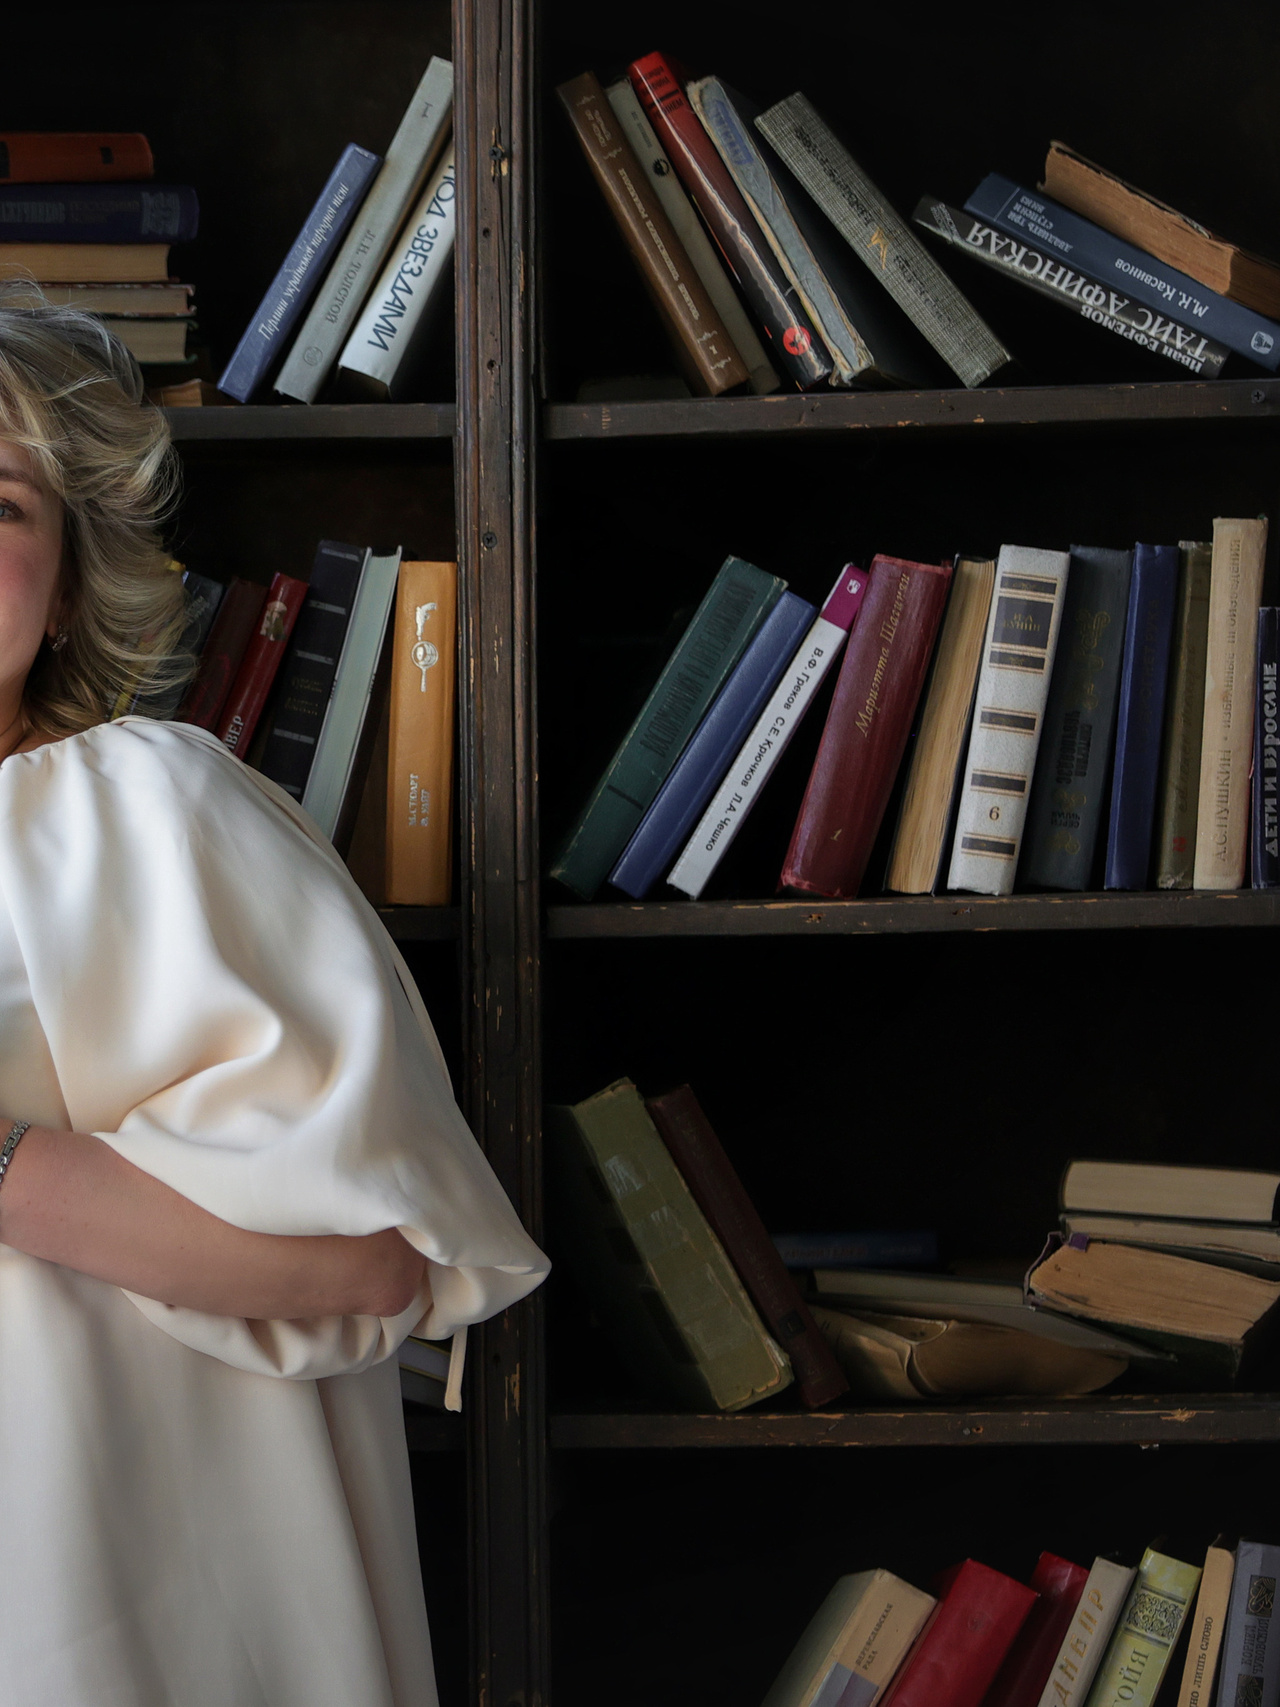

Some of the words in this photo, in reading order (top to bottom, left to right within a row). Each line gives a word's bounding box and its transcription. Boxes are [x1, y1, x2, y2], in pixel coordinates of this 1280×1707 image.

[258, 296, 288, 341] Перлини
[283, 246, 316, 301] української
[312, 205, 340, 249] народної
[331, 182, 349, 208] пісні
[355, 228, 376, 258] Л.Н.
[367, 225, 438, 352] ЗВЕЗДАМИ
[966, 221, 1130, 314] АФИНСКАЯ
[1114, 257, 1176, 299] Касвинов
[325, 260, 361, 324] ТОЛСТОЙ
[1173, 291, 1209, 318] М.К.
[1080, 303, 1159, 351] ЕФРЕМОВ
[1137, 305, 1208, 360] ТАИС
[1161, 345, 1203, 373] Иван
[803, 645, 824, 673] В.Ф.
[854, 647, 890, 738] Мариэтта
[880, 573, 910, 643] Шагинян
[639, 672, 704, 757] ВОСПОМИНАНИЯ
[682, 662, 709, 680] О
[783, 672, 810, 710] Греков
[766, 714, 786, 739] С.Е.
[1263, 662, 1278, 767] ВЗРОСЛЫЕ
[741, 739, 773, 788] Крючков
[1262, 776, 1276, 791] И
[724, 792, 743, 817] Л.А.
[989, 806, 999, 821] 6
[705, 815, 730, 851] Чешко
[1263, 798, 1278, 857] ДЕТИ
[862, 1648, 878, 1671] РАДА
[1052, 1588, 1104, 1707] ДНЕПР
[1189, 1691, 1199, 1707] НО
